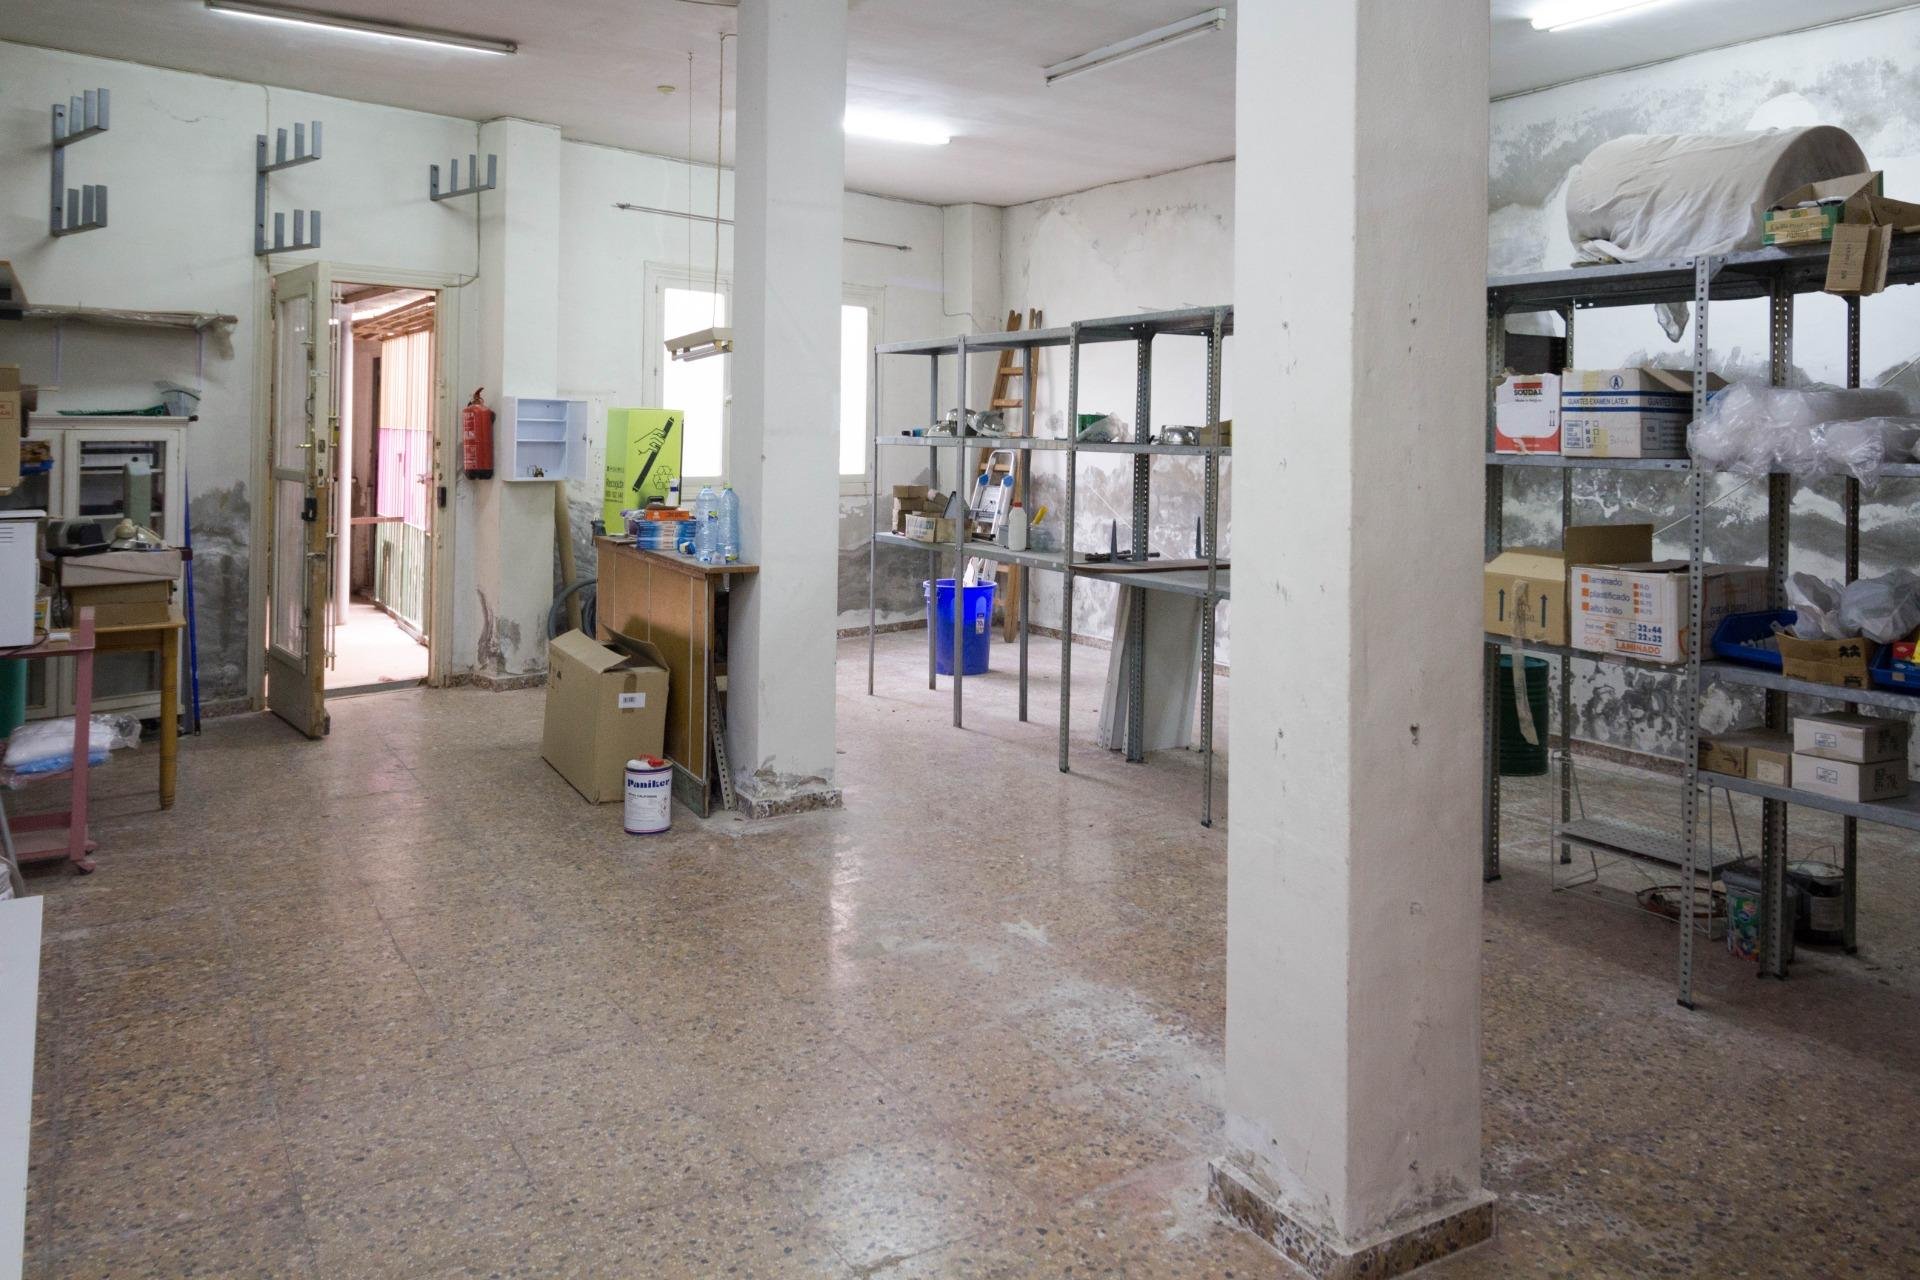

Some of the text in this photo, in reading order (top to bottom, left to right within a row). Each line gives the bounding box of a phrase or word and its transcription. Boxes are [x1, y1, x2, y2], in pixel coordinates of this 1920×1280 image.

[1590, 590, 1631, 602] plastificado
[1616, 640, 1661, 655] LAMINADO
[627, 778, 670, 789] Paniker
